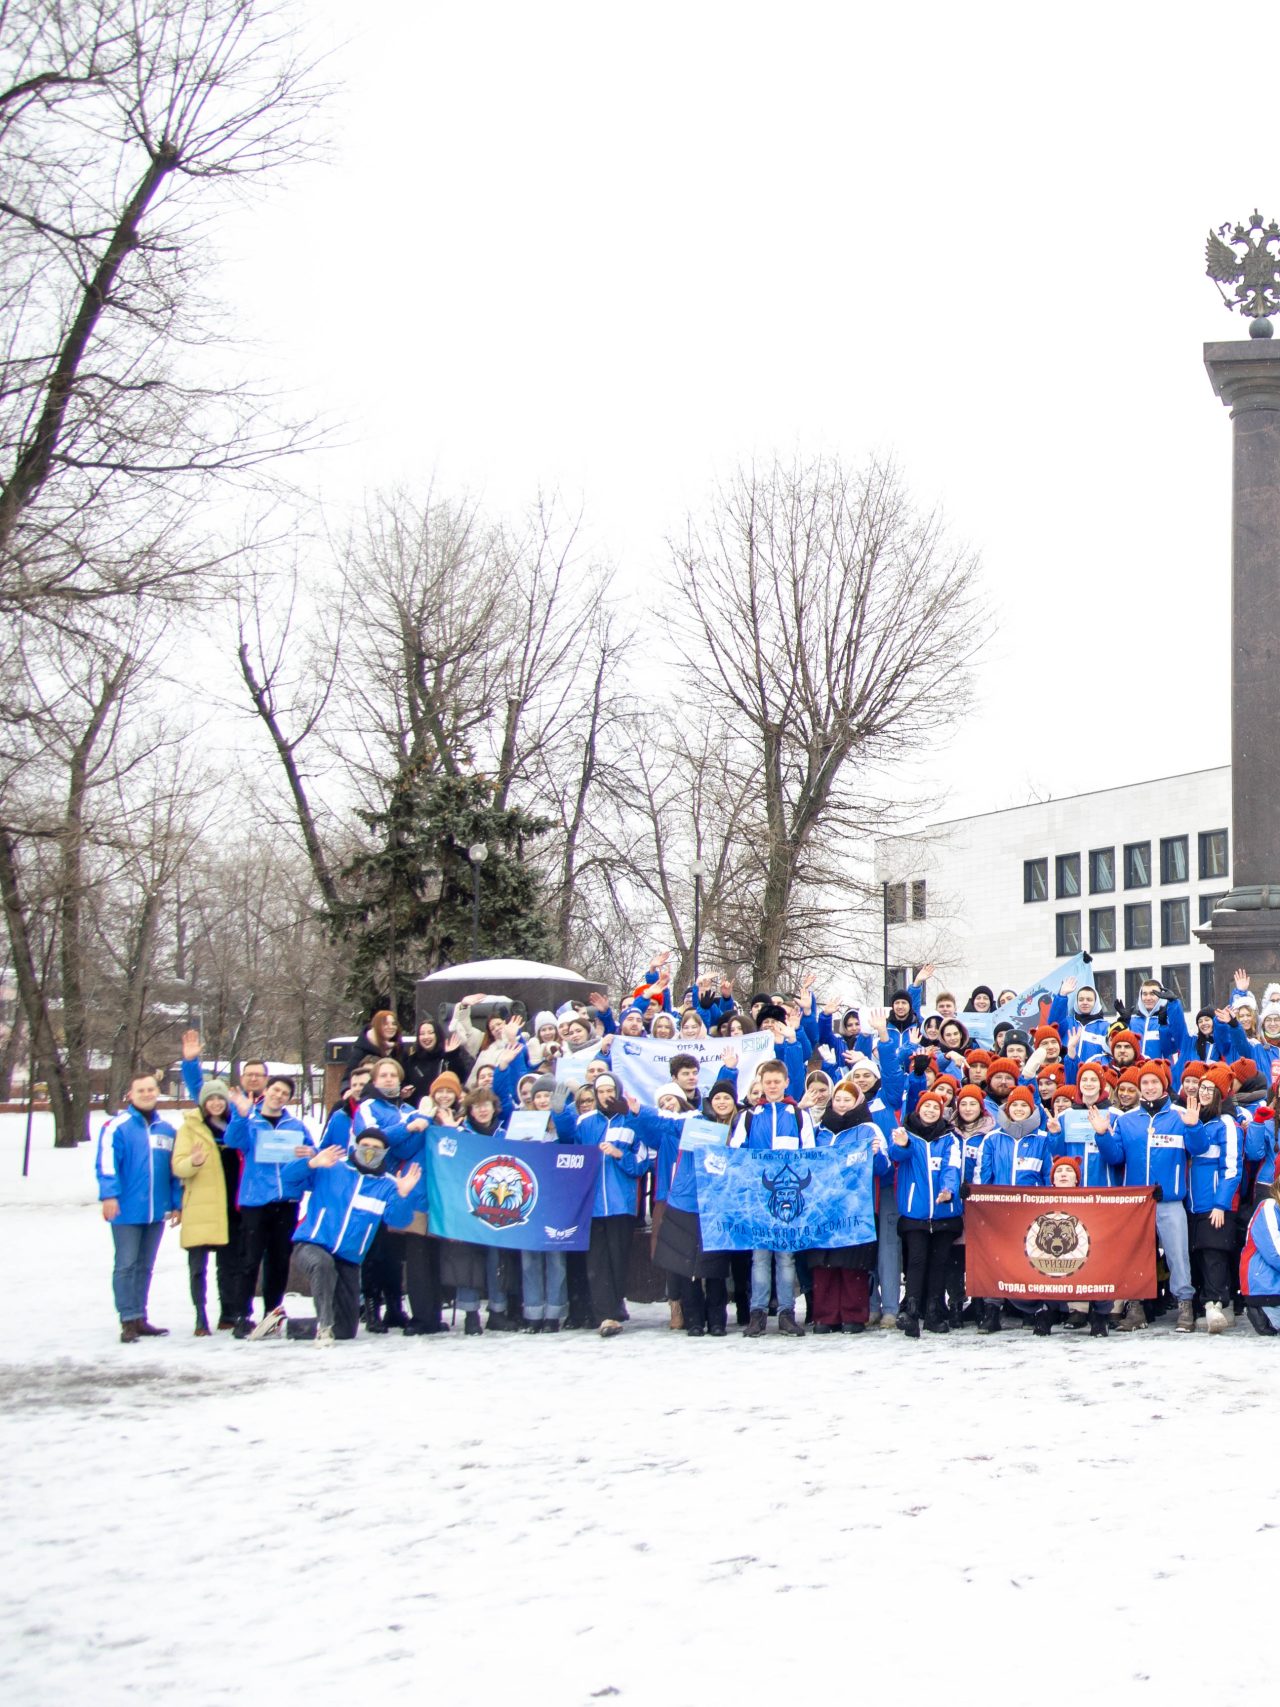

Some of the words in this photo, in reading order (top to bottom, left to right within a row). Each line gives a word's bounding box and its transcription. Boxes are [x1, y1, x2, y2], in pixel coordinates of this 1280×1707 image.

[677, 1043, 705, 1051] ОТРЯД
[1023, 1194, 1094, 1204] Государственный
[1096, 1194, 1147, 1204] Университет
[998, 1281, 1026, 1293] Отряд
[1028, 1282, 1073, 1294] снежного
[1075, 1284, 1115, 1294] десанта
